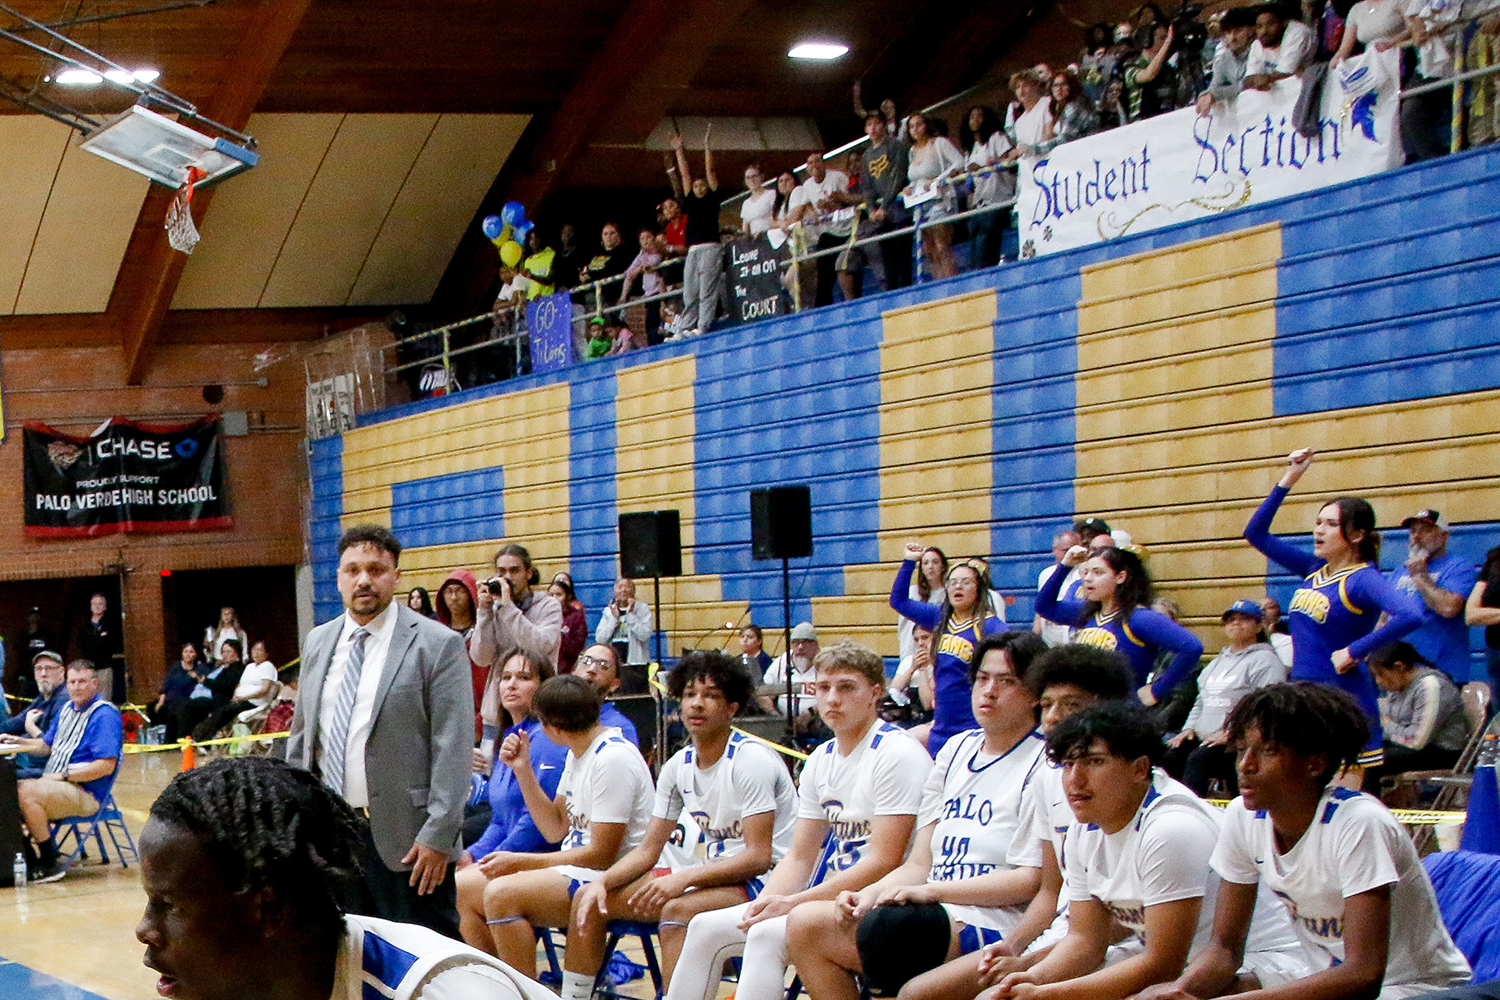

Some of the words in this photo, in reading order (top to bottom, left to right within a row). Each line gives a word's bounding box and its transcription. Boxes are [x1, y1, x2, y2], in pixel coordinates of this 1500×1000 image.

[1030, 144, 1152, 231] Student
[1192, 114, 1343, 185] Section
[732, 245, 759, 266] Leave
[535, 301, 555, 334] GO
[741, 295, 780, 321] COURT
[96, 437, 173, 460] CHASE
[36, 493, 71, 511] PALO
[75, 489, 121, 510] VERDE
[122, 489, 154, 506] HIGH
[158, 485, 218, 505] SCHOOL
